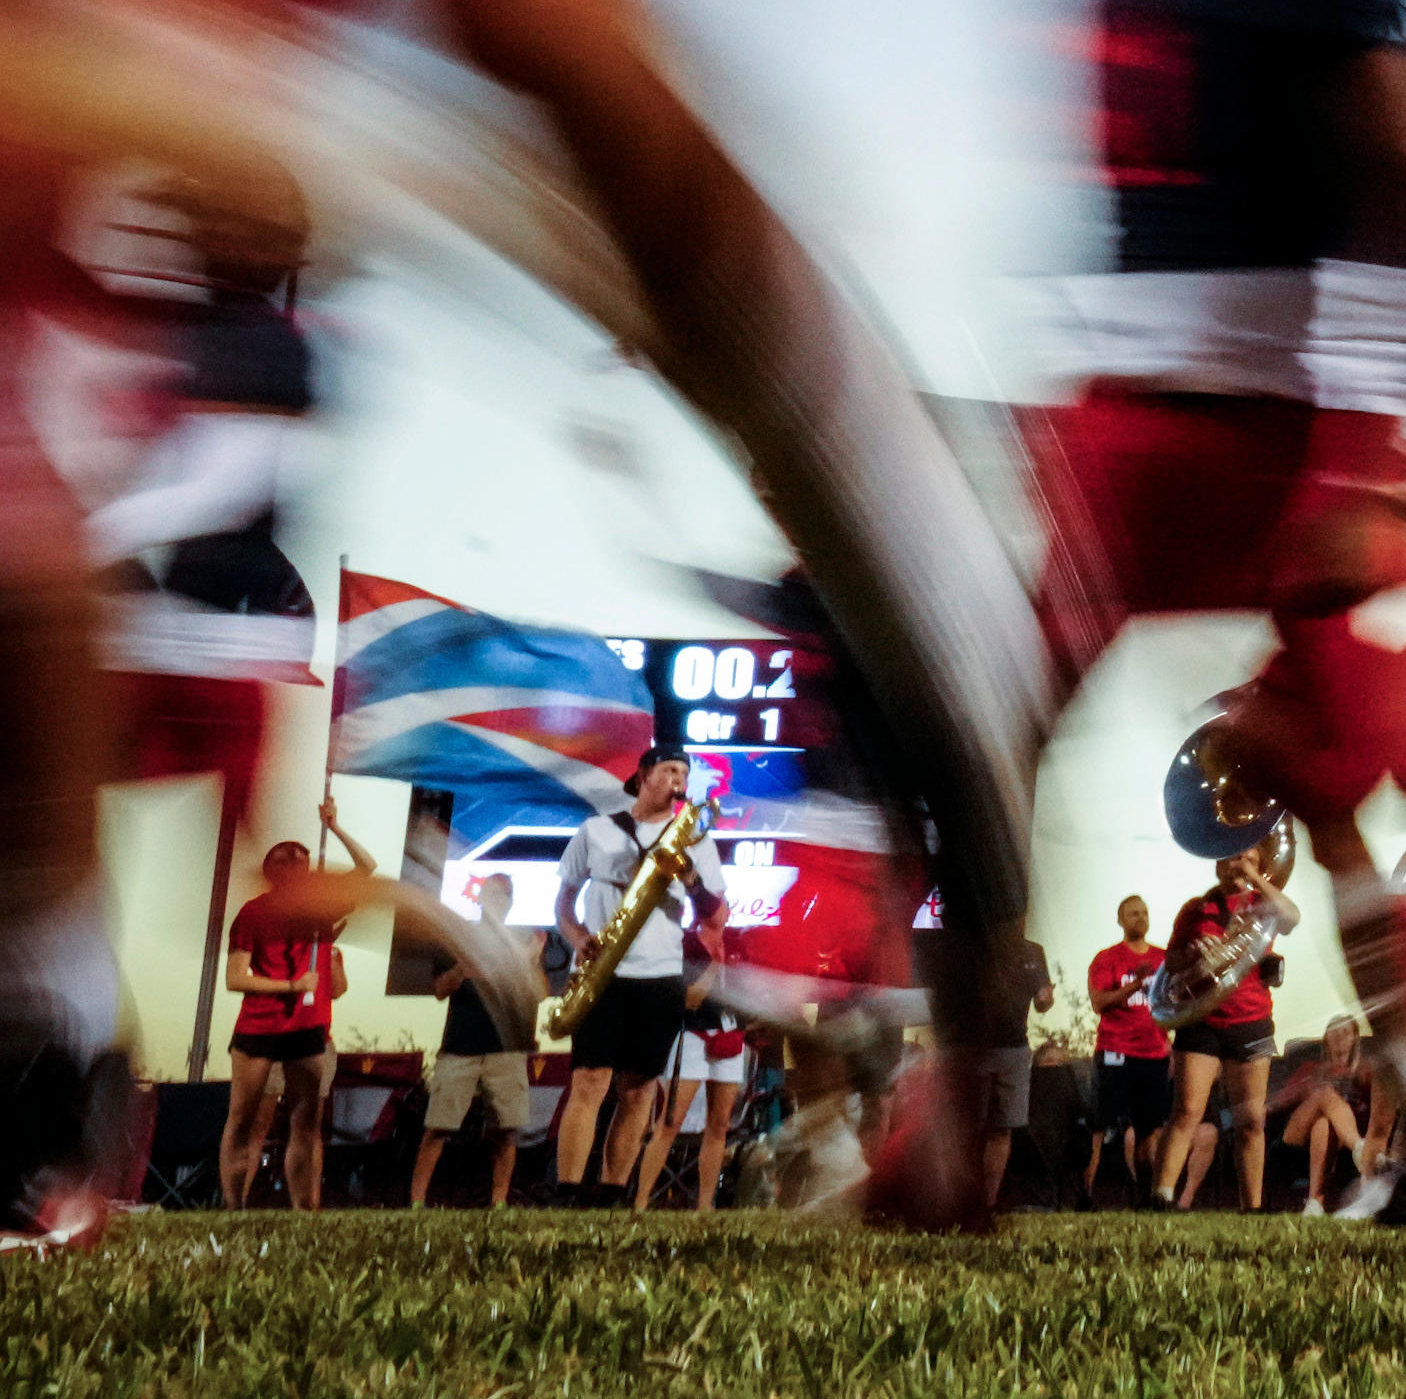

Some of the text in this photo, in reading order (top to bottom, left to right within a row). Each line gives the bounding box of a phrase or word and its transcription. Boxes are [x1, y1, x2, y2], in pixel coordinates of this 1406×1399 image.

[672, 645, 797, 701] 00.2
[686, 708, 780, 743] Qtr 1
